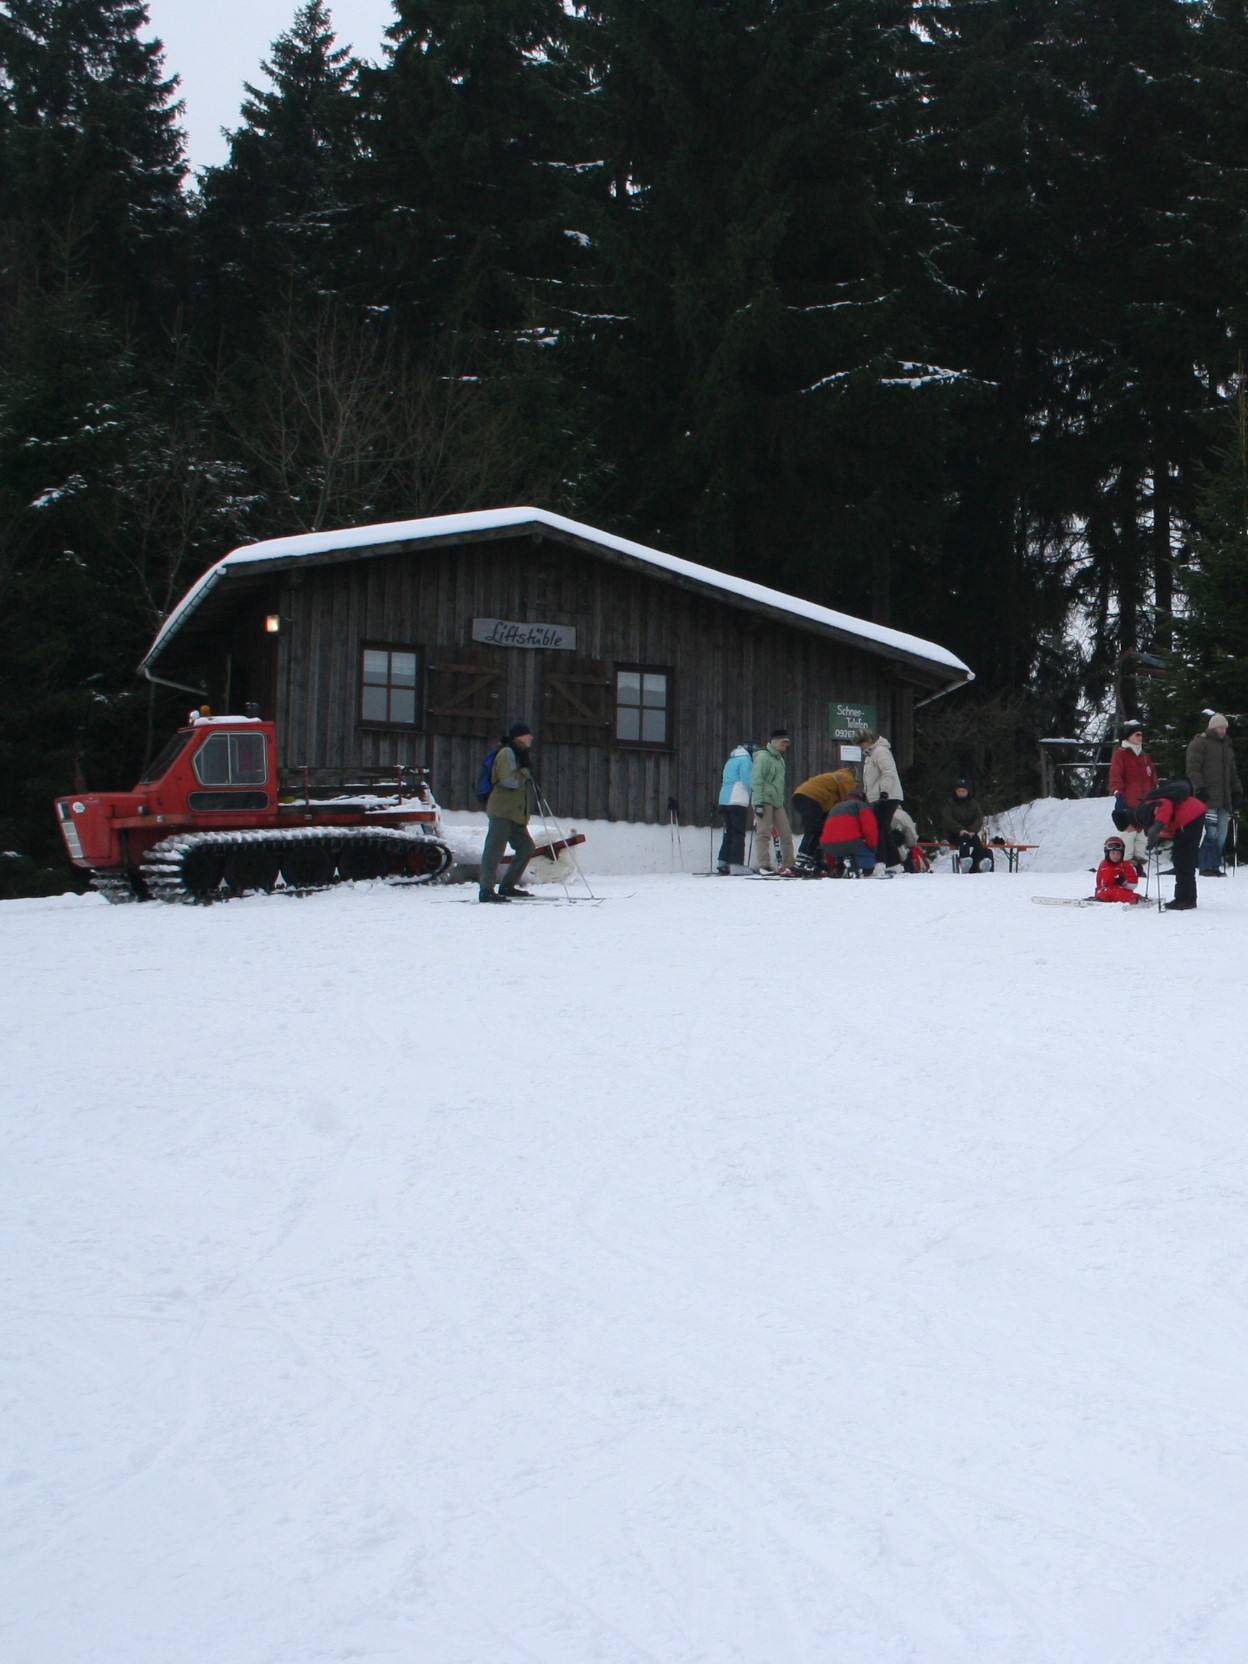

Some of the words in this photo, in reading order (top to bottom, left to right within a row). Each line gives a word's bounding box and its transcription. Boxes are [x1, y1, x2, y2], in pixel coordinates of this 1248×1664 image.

[484, 621, 563, 647] Liftstüble
[836, 704, 865, 717] Schnee-
[846, 716, 869, 729] Telefon
